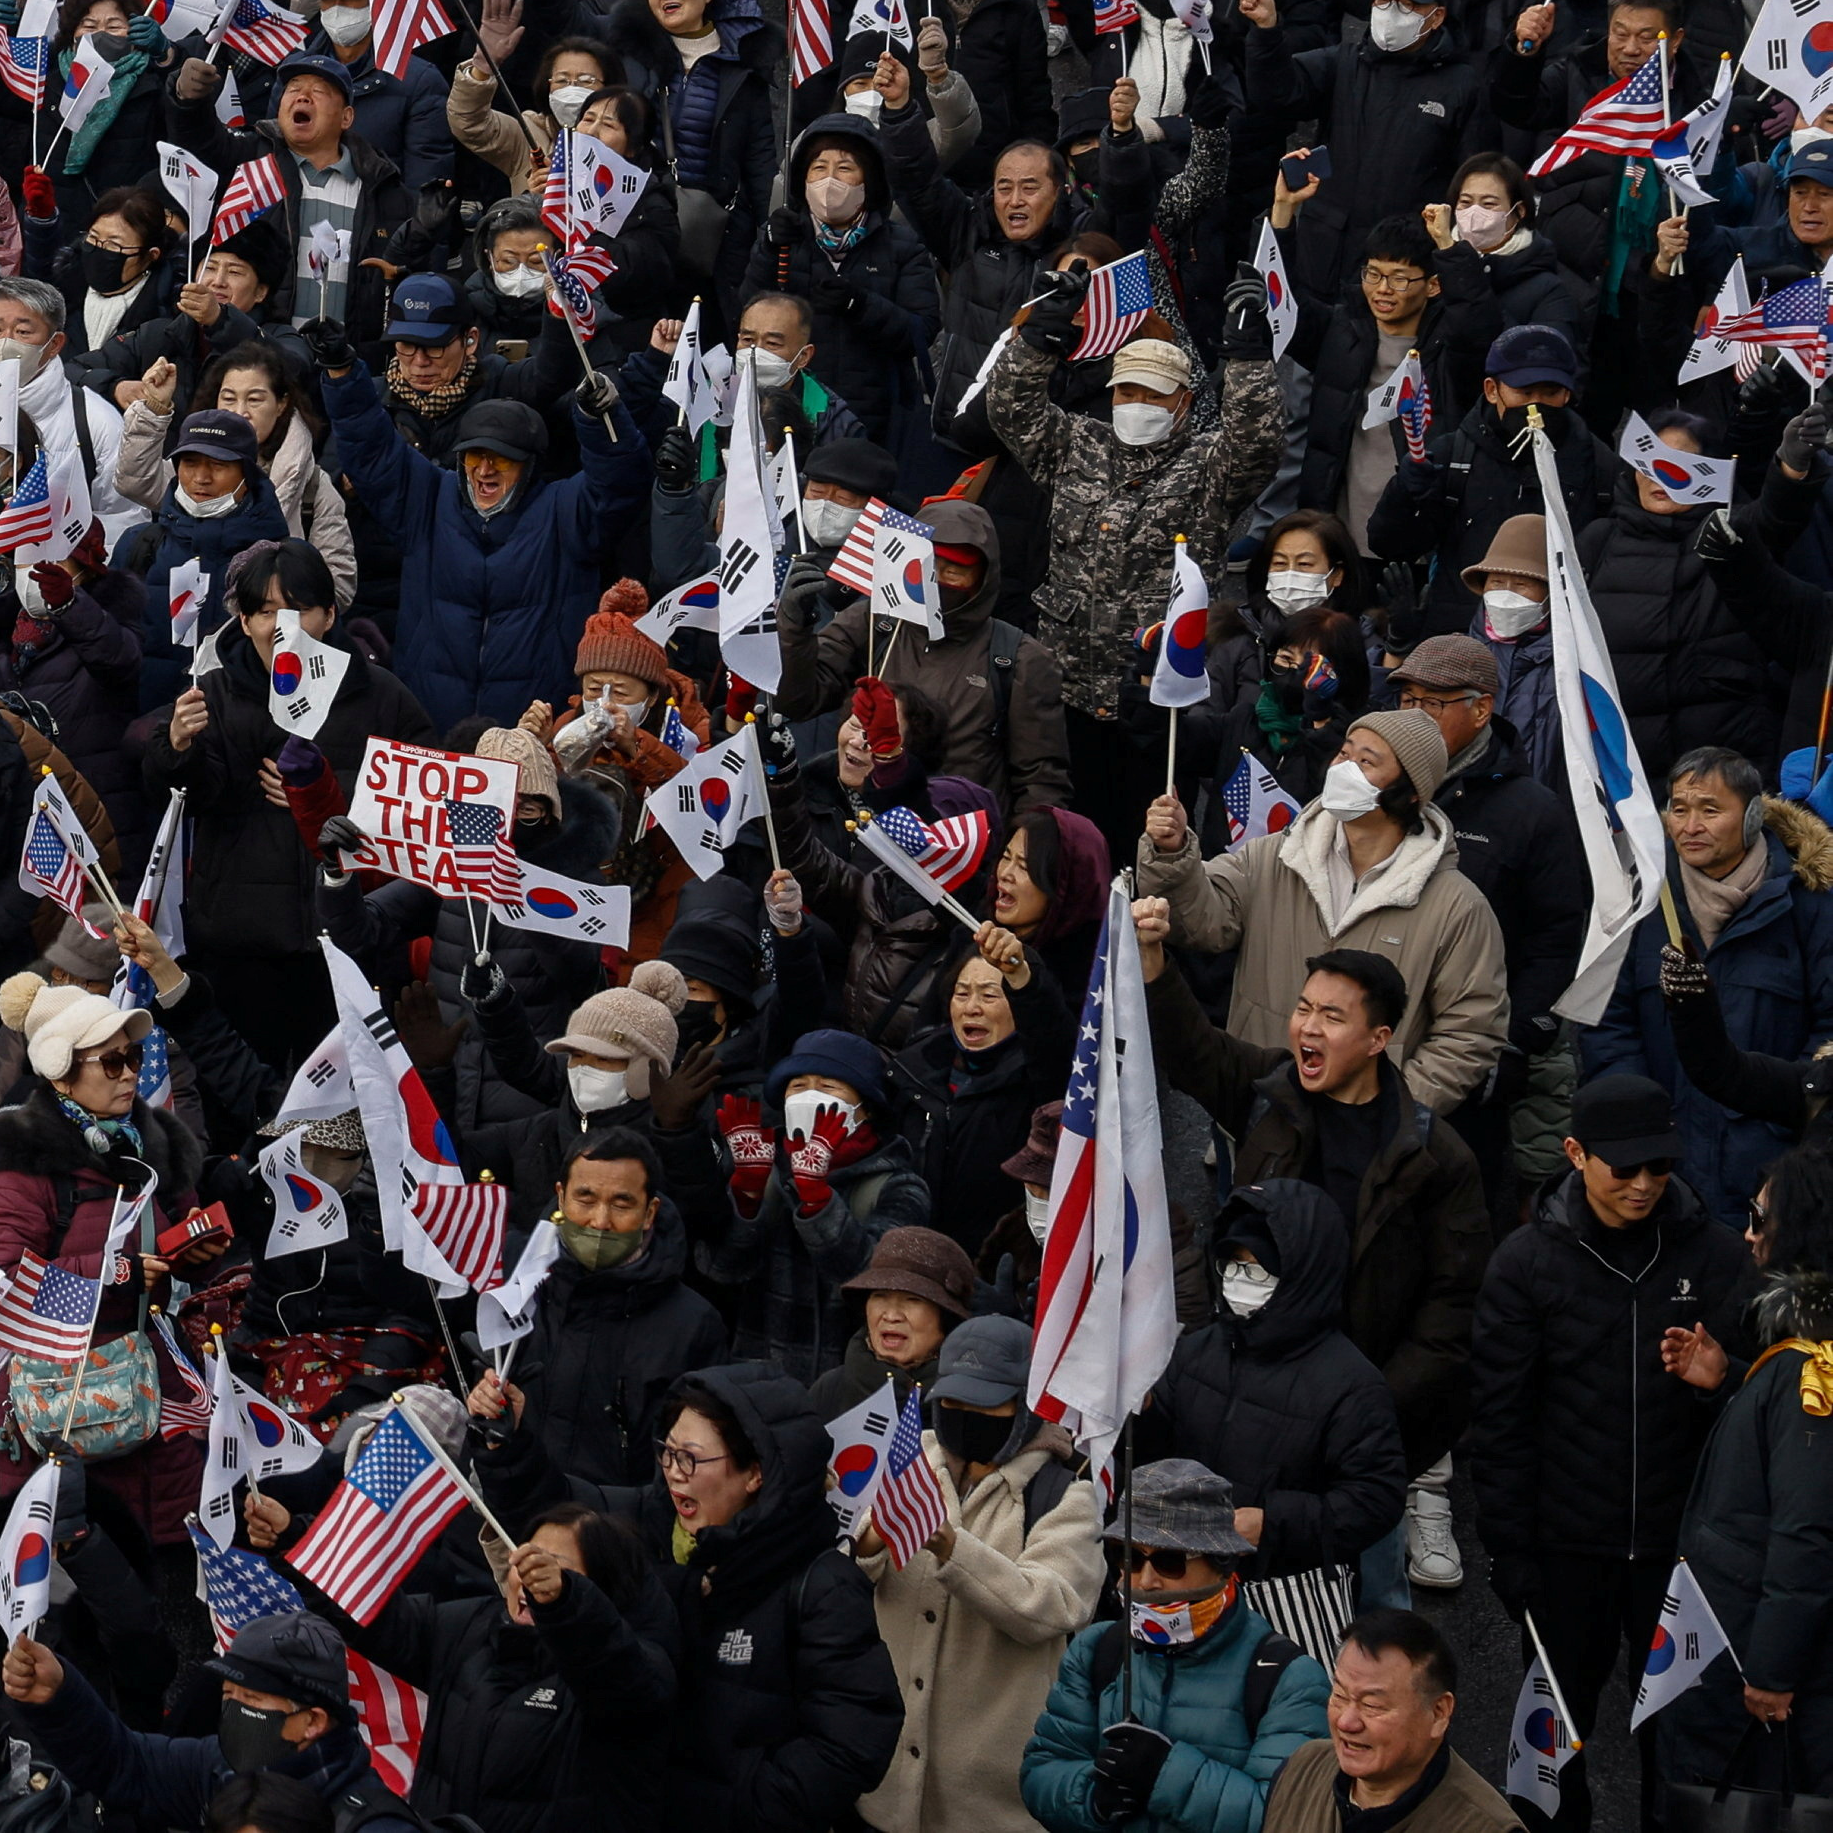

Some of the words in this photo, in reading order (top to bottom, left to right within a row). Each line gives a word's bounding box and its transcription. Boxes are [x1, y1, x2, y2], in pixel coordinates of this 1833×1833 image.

[366, 750, 490, 803] STOP
[374, 794, 454, 849] THE
[351, 835, 466, 895] STEA
